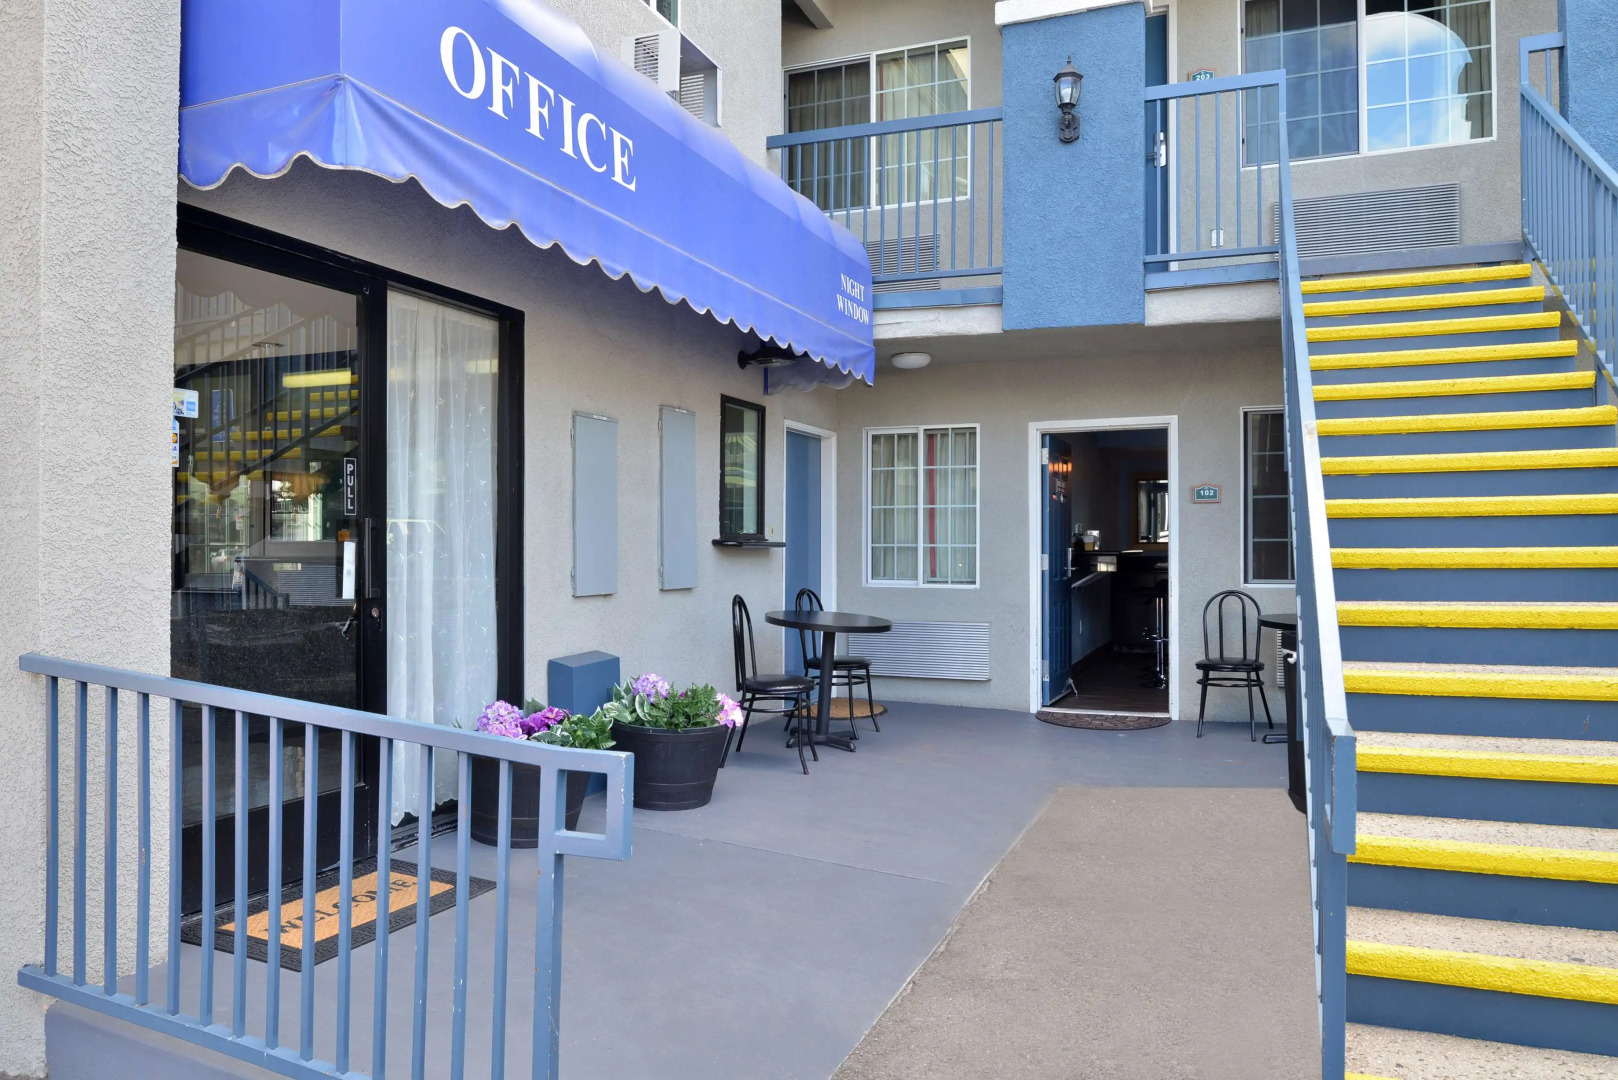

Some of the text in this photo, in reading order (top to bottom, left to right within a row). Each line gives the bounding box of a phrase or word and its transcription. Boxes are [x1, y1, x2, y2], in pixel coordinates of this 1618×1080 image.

[1195, 73, 1210, 81] 203
[440, 26, 636, 192] OFFICE
[840, 272, 865, 302] NIGHT
[836, 293, 870, 326] WINDOW
[346, 463, 354, 510] PULL
